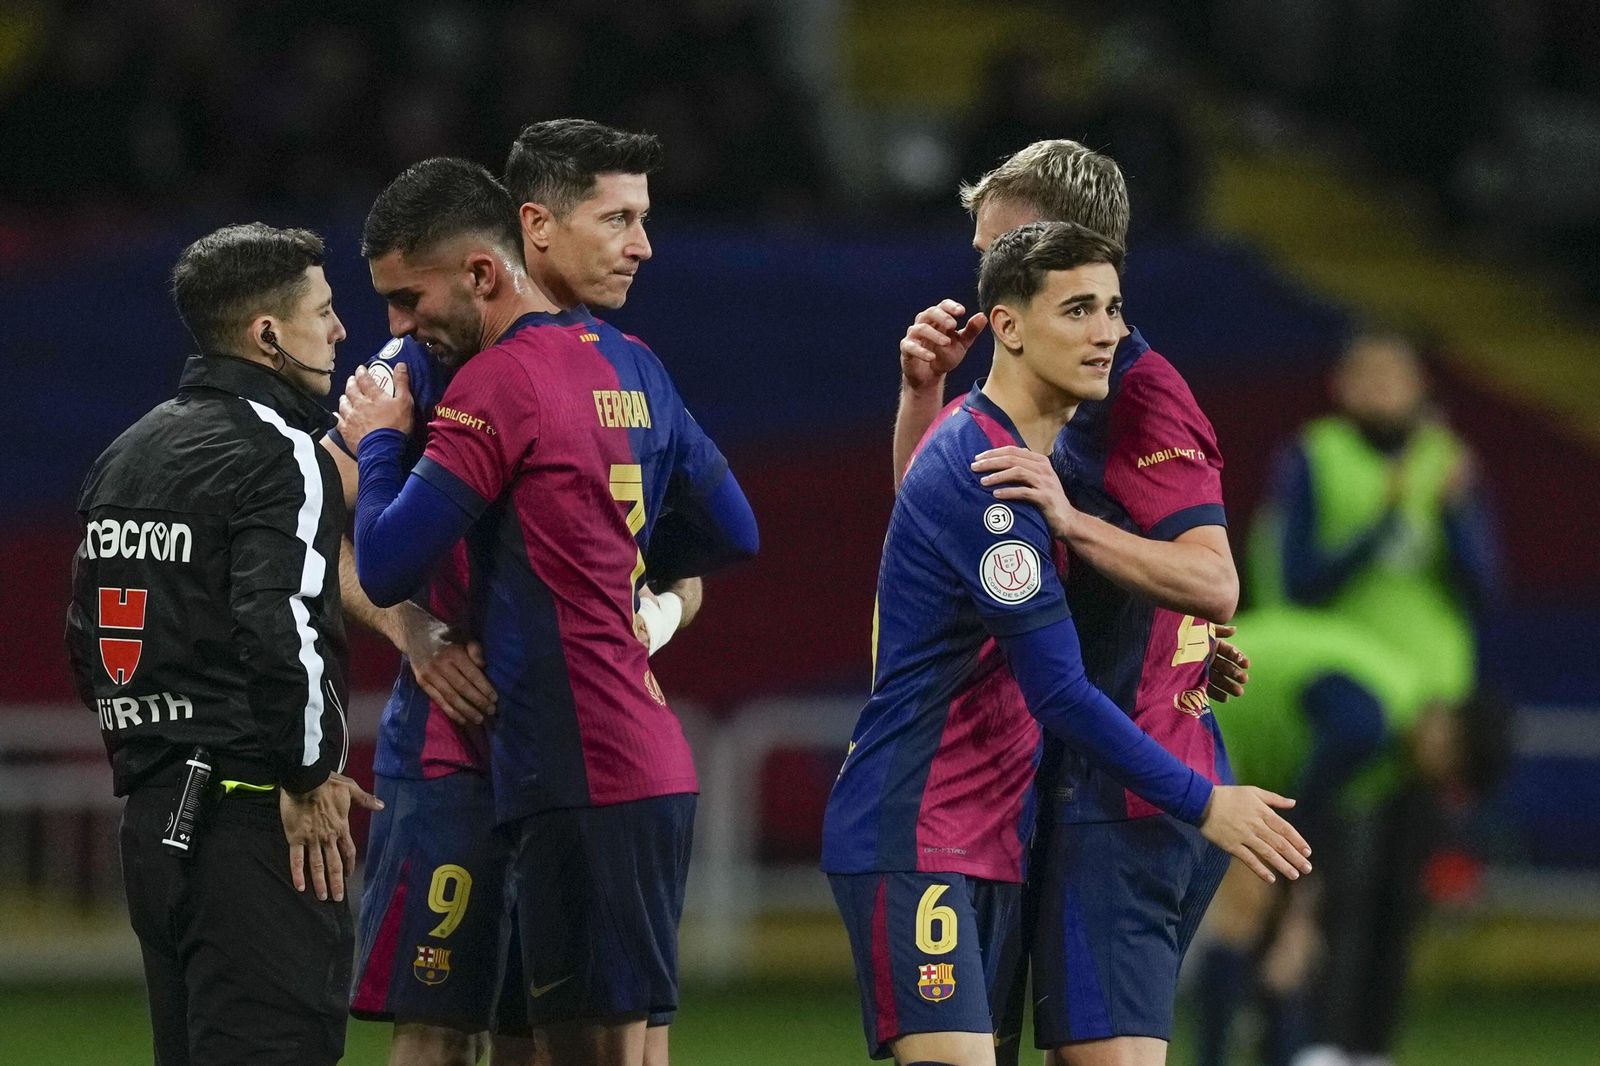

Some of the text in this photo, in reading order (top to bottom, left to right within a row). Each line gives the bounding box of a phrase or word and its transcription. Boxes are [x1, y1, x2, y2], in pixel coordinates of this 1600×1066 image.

[609, 464, 647, 618] 7
[992, 514, 1006, 523] 31
[427, 863, 473, 938] 9
[915, 884, 958, 955] 6
